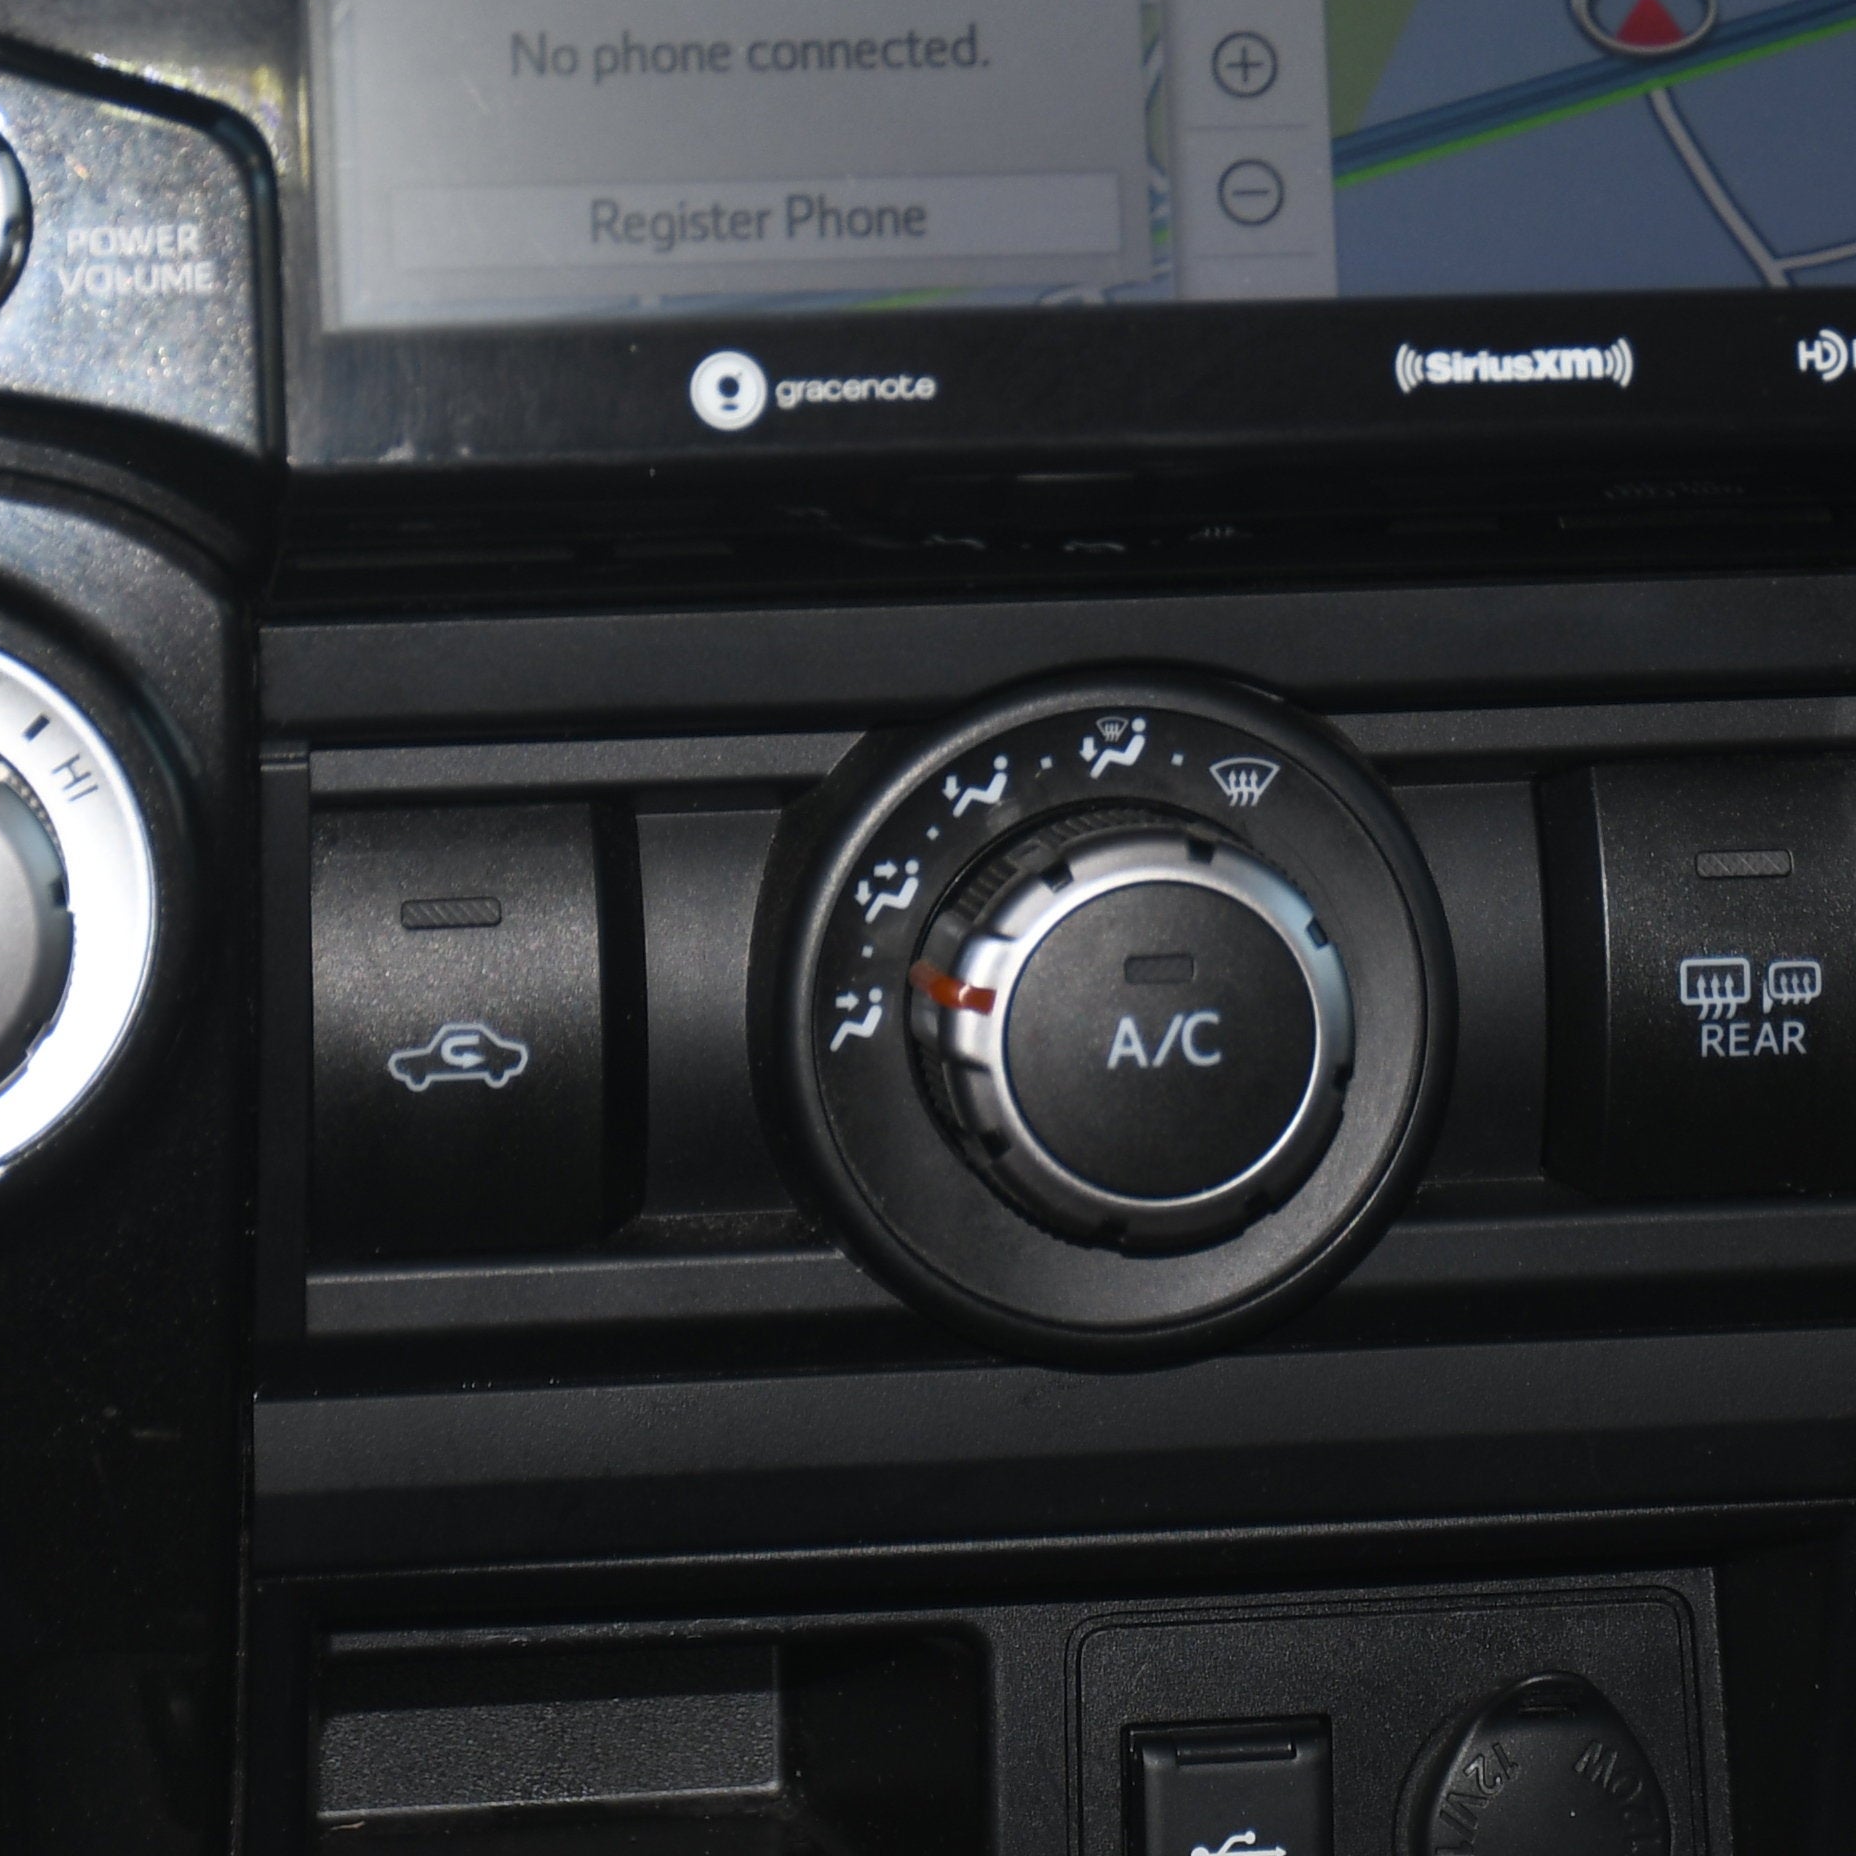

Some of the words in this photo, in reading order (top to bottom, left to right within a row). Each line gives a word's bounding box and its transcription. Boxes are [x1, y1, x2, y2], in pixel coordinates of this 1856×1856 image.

[510, 31, 580, 78] No
[592, 28, 732, 86] phone
[746, 22, 992, 74] connected.
[66, 222, 201, 259] POWER
[589, 197, 774, 254] Register
[784, 192, 928, 241] Phone
[56, 258, 216, 297] VOLUME
[774, 373, 938, 411] gracenote
[50, 752, 99, 803] HI
[1106, 1011, 1223, 1070] A/C
[1700, 1019, 1807, 1059] REAR
